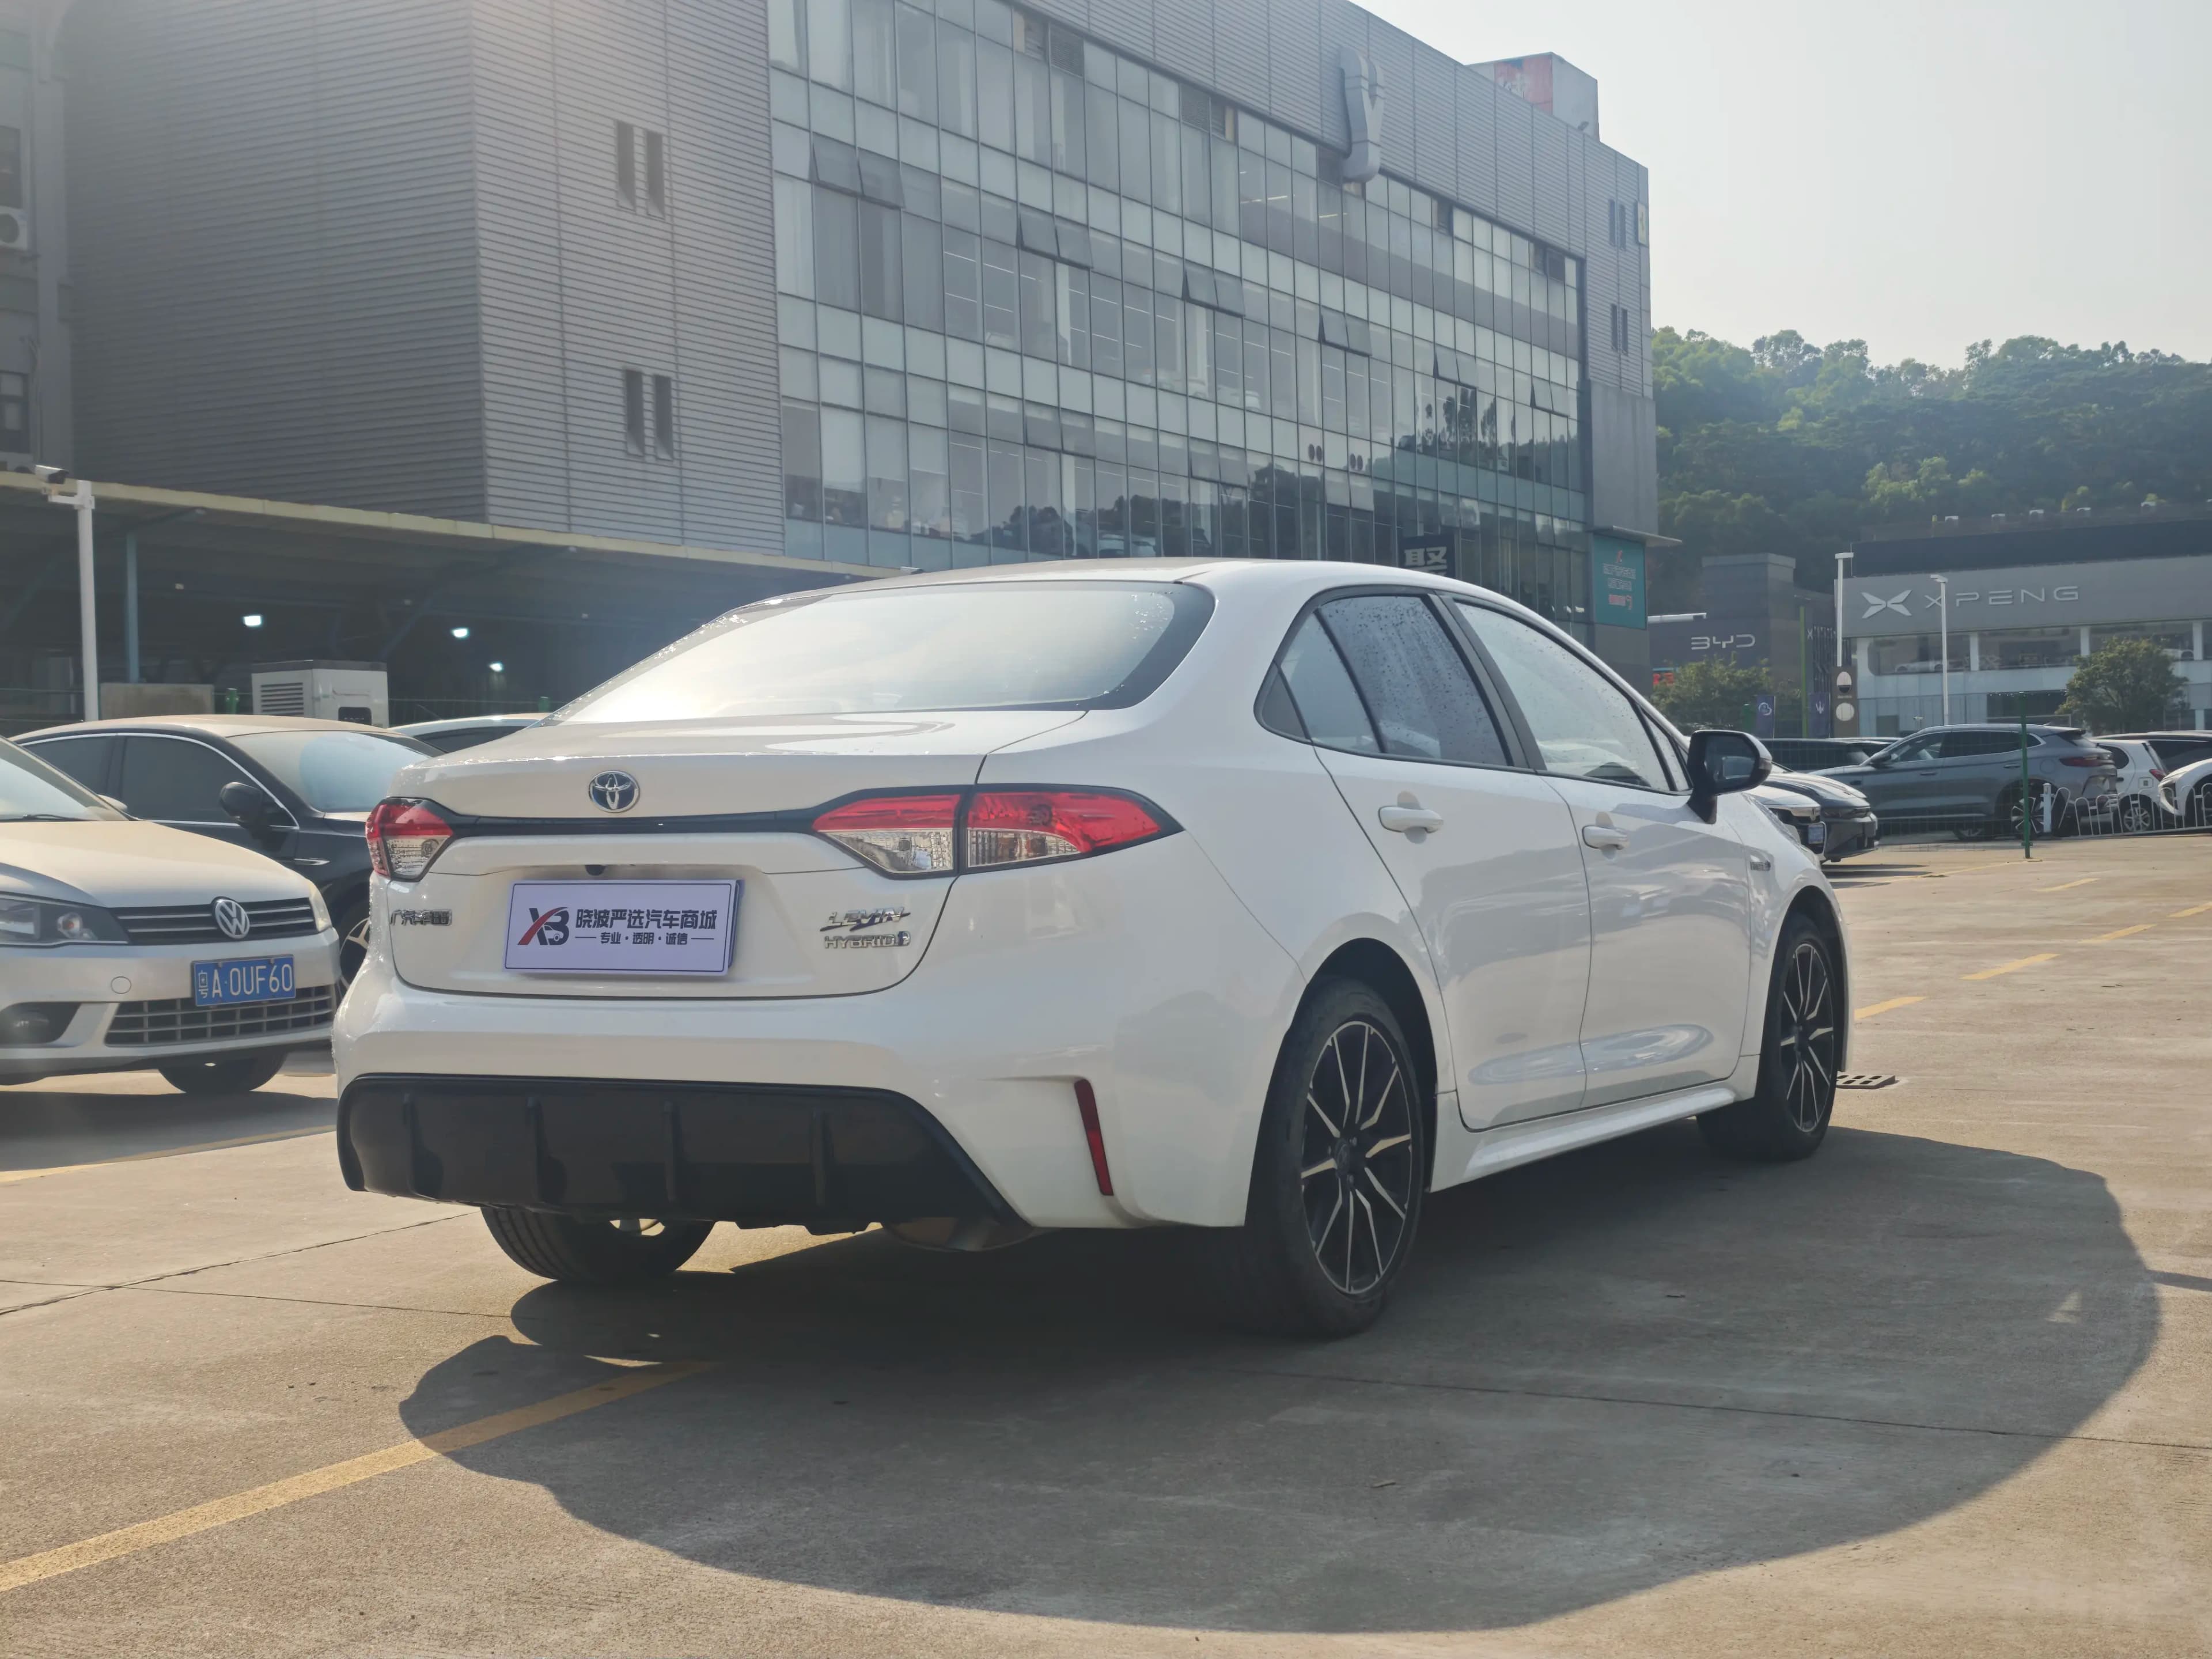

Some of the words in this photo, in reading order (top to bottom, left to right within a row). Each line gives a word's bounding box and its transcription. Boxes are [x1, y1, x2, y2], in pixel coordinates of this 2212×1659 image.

[1925, 586, 2079, 609] XPENG
[1691, 634, 1756, 650] BYD
[576, 909, 718, 929] 晓波严选汽车商城
[824, 934, 896, 949] HYBRID
